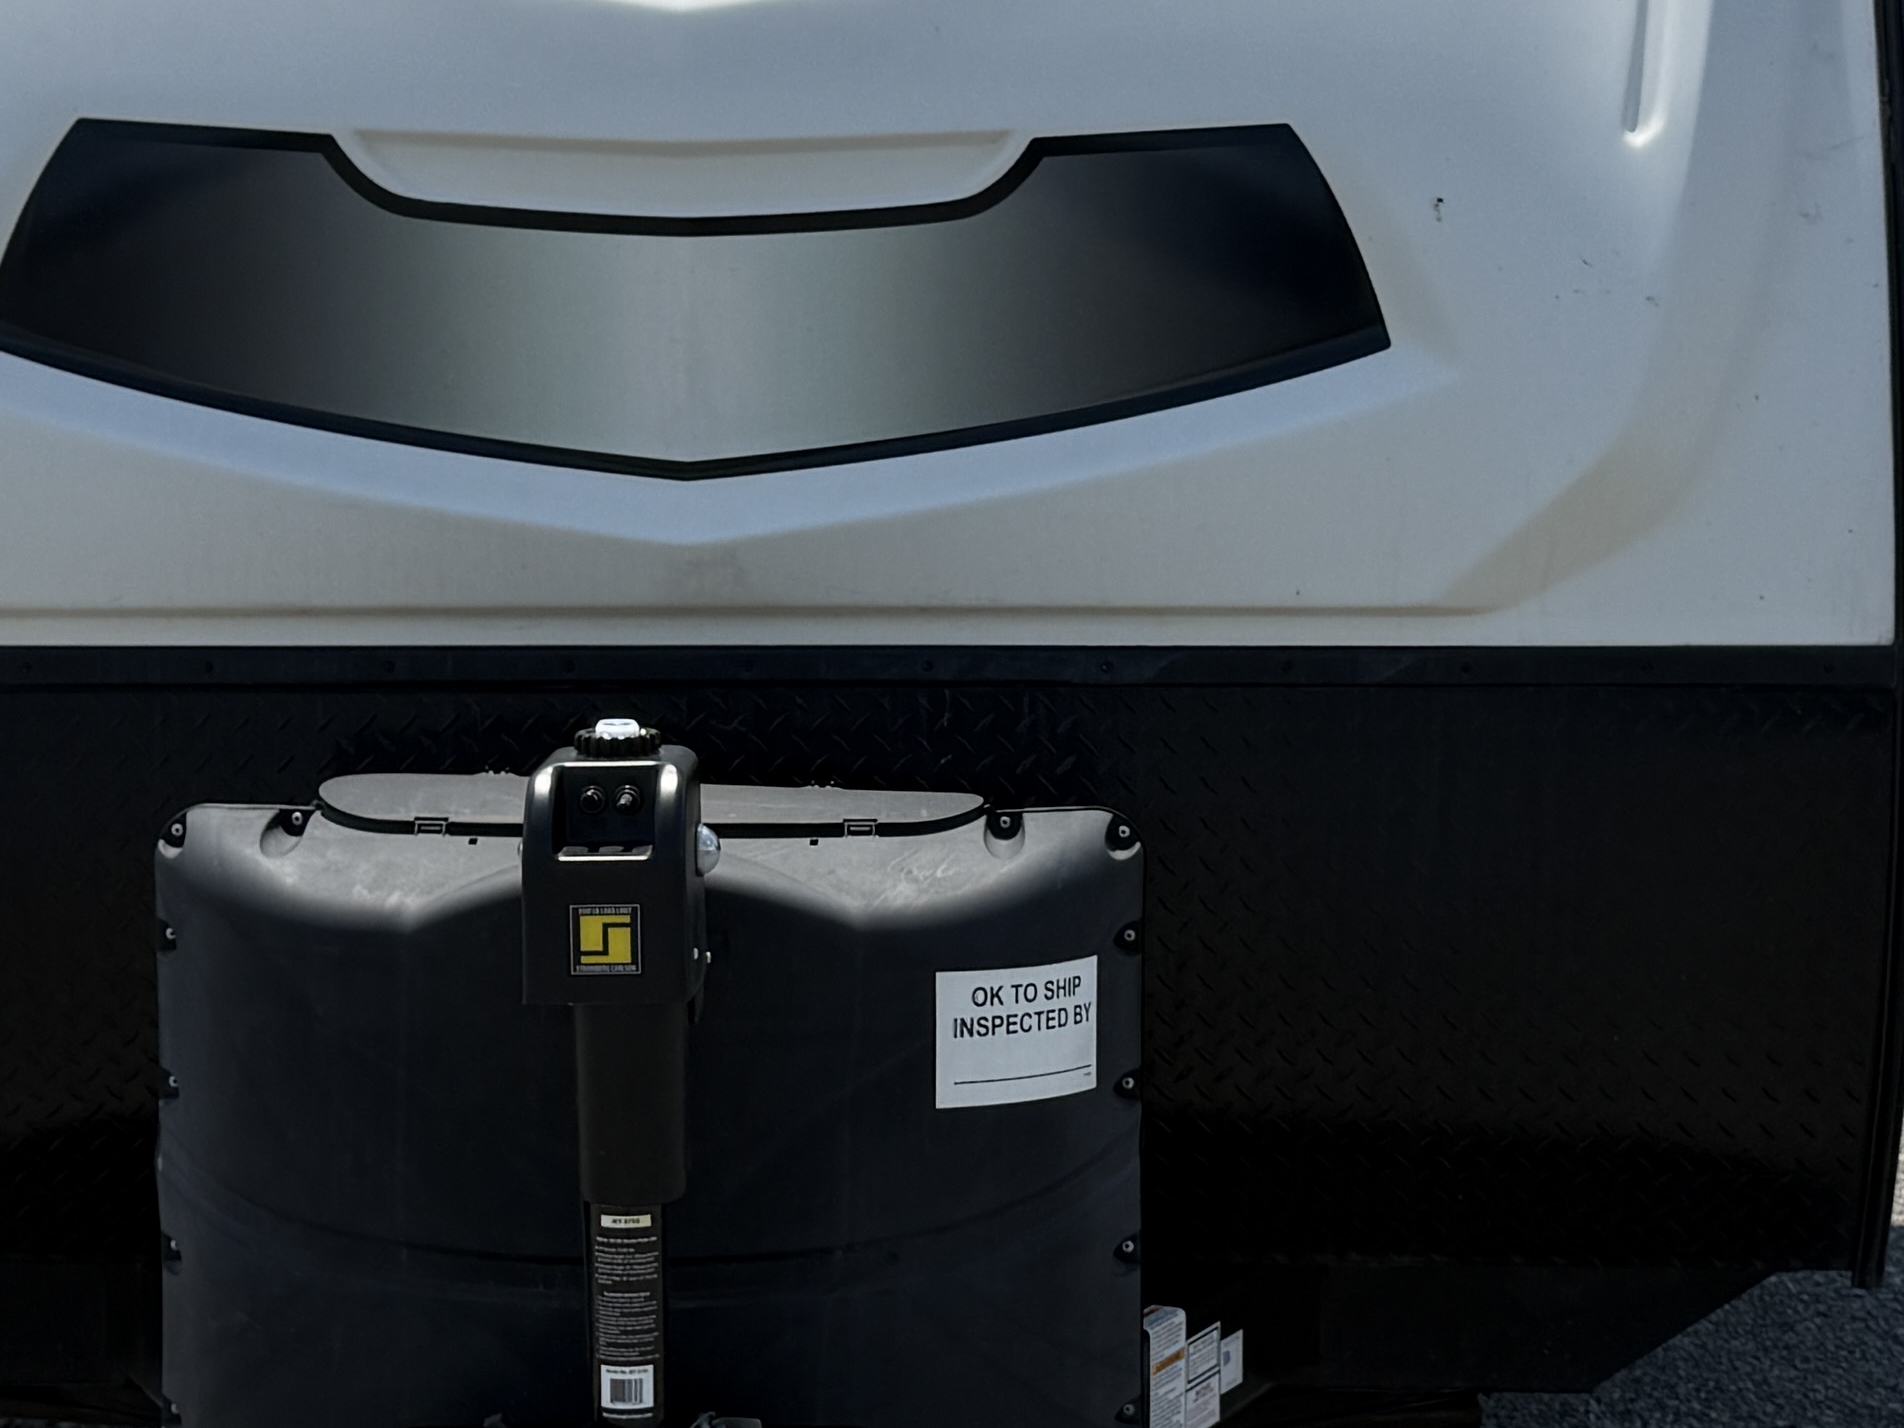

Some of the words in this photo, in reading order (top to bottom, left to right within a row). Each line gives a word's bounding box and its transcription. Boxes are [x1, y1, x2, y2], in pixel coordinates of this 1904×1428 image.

[971, 985, 1005, 1008] OK
[1011, 982, 1038, 1005] TO
[1044, 975, 1082, 1001] SHIP
[953, 1007, 1069, 1039] INSPECTED
[1073, 1001, 1093, 1025] BY
